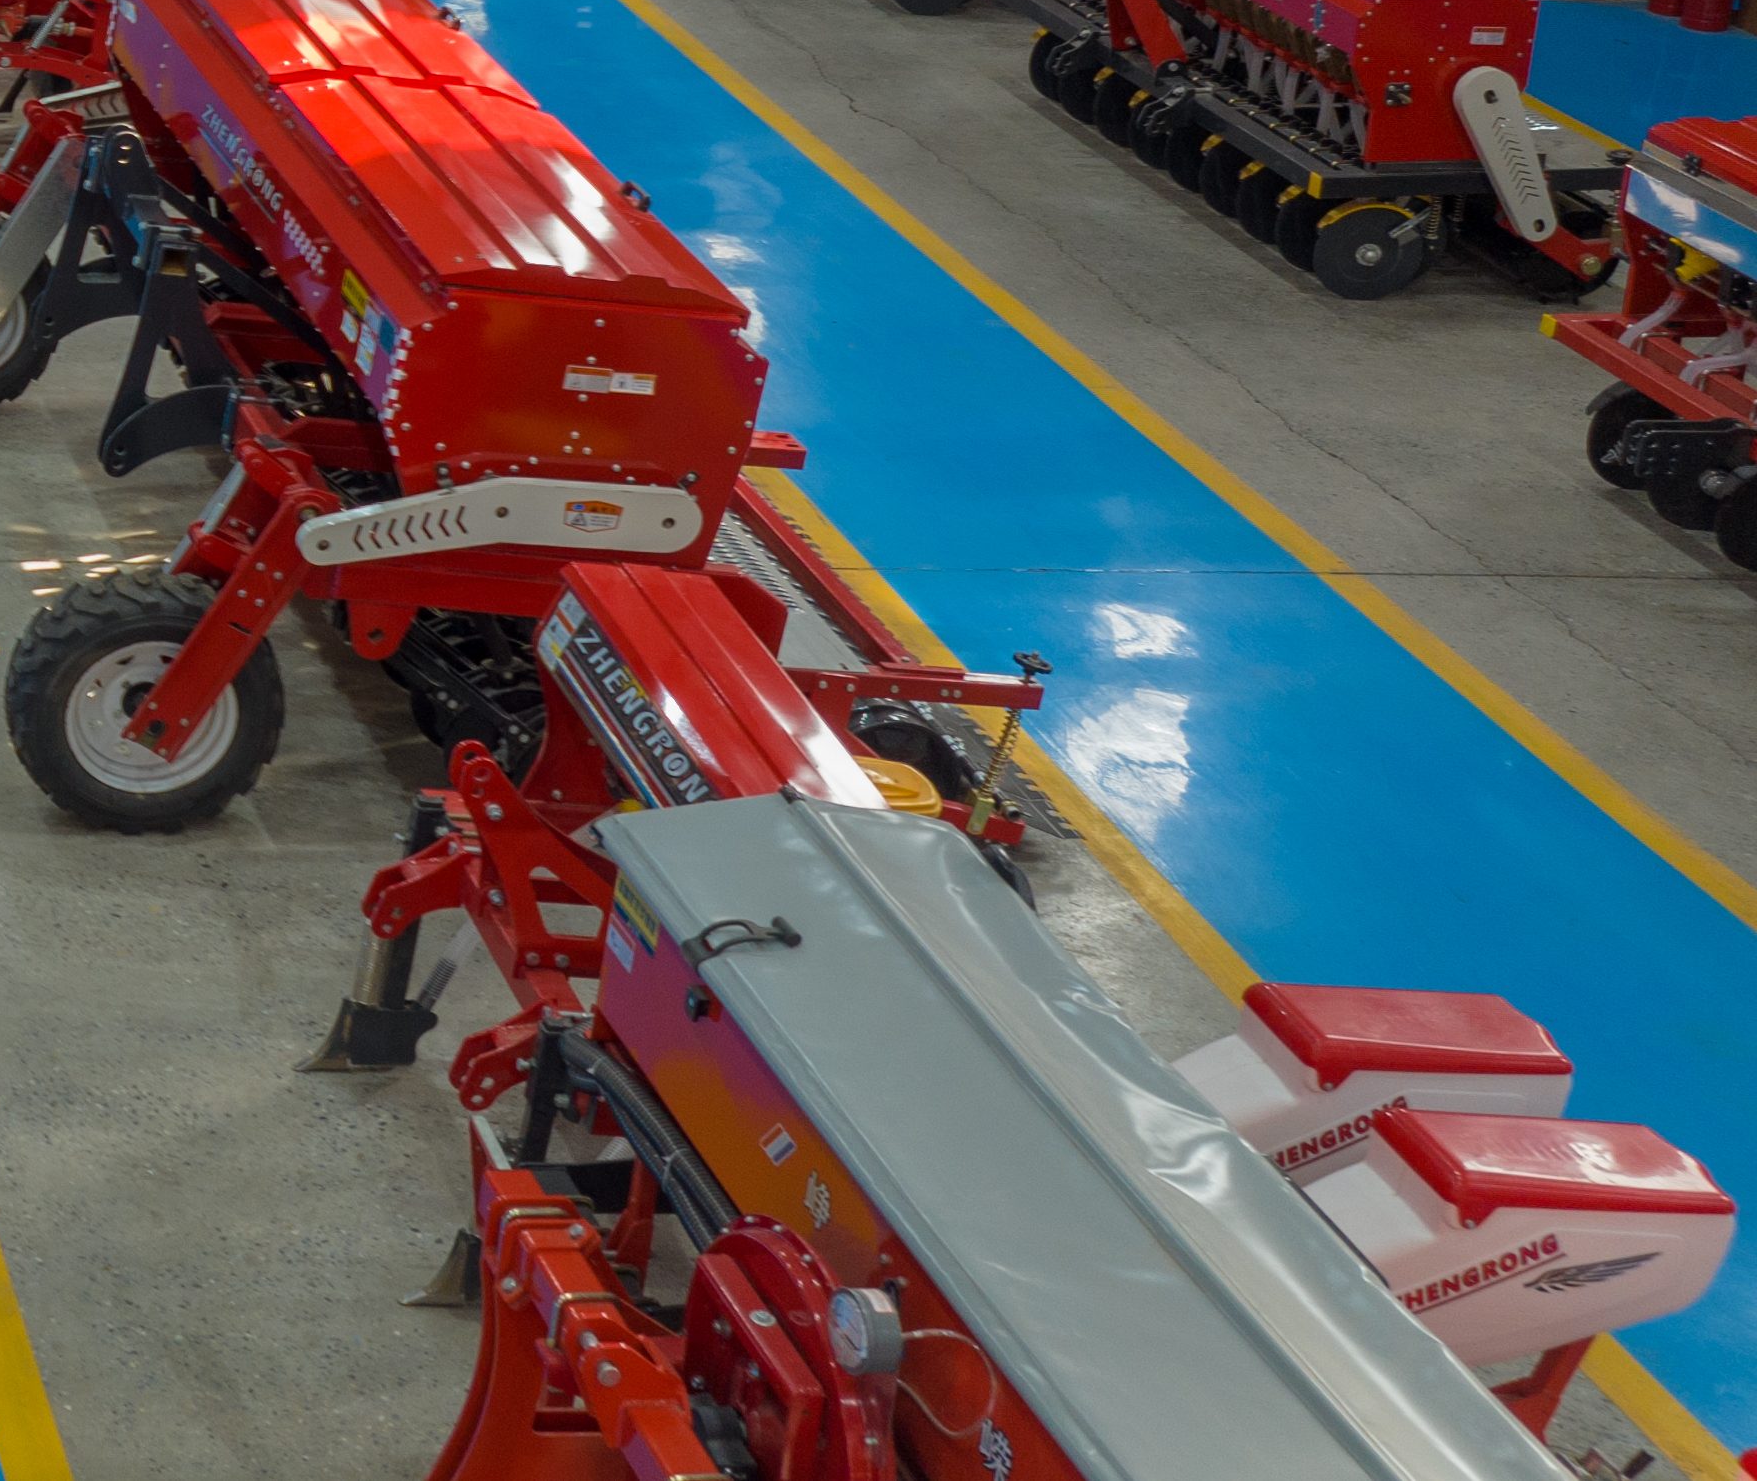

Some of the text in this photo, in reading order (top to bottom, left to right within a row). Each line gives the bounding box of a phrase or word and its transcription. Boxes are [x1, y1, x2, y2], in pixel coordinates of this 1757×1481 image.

[201, 104, 284, 211] ZHENGRONG
[573, 627, 710, 804] ZHENGRON
[1397, 1233, 1561, 1311] HENGRONG
